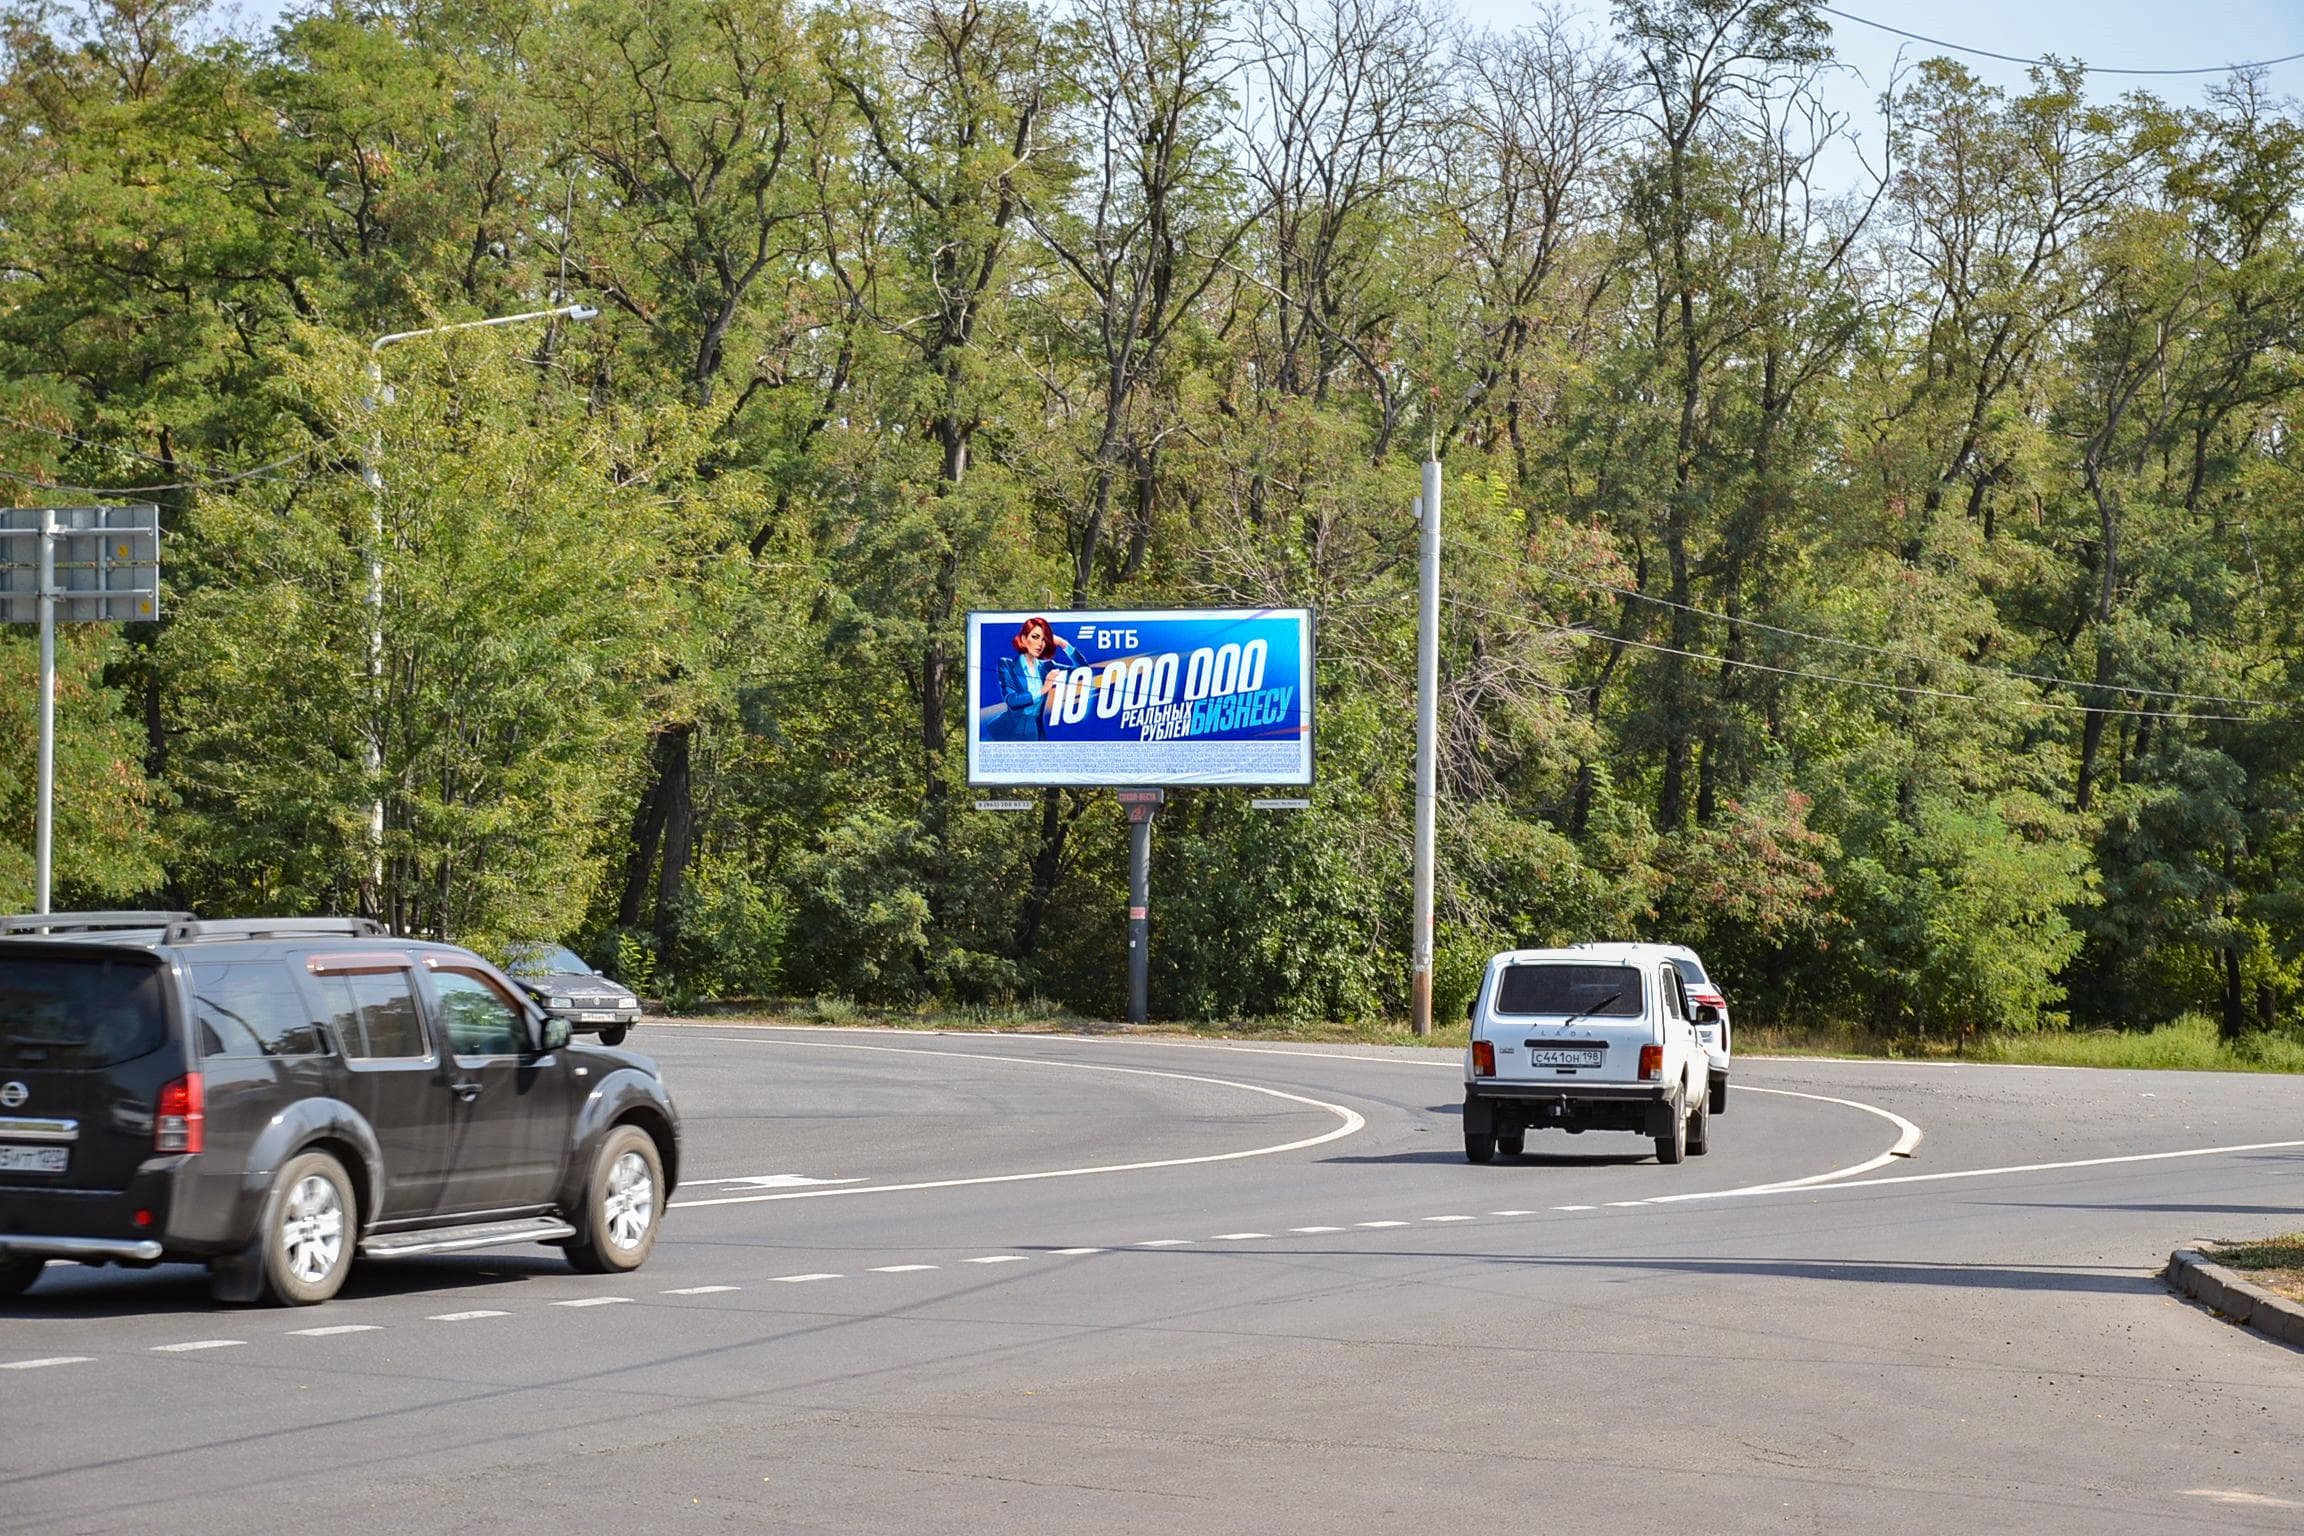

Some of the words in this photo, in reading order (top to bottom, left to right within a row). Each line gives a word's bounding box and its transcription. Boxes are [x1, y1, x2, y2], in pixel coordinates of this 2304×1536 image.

[1098, 629, 1139, 650] ВТБ
[1049, 666, 1093, 727] 10
[1096, 653, 1180, 719] 000
[1184, 639, 1269, 701] 000
[1120, 700, 1194, 729] РЕАЛЬНЫХ
[1190, 686, 1294, 736] БИЗНЕСУ
[1139, 718, 1192, 742] РУБЛЕЙ
[1582, 1052, 1599, 1061] 198
